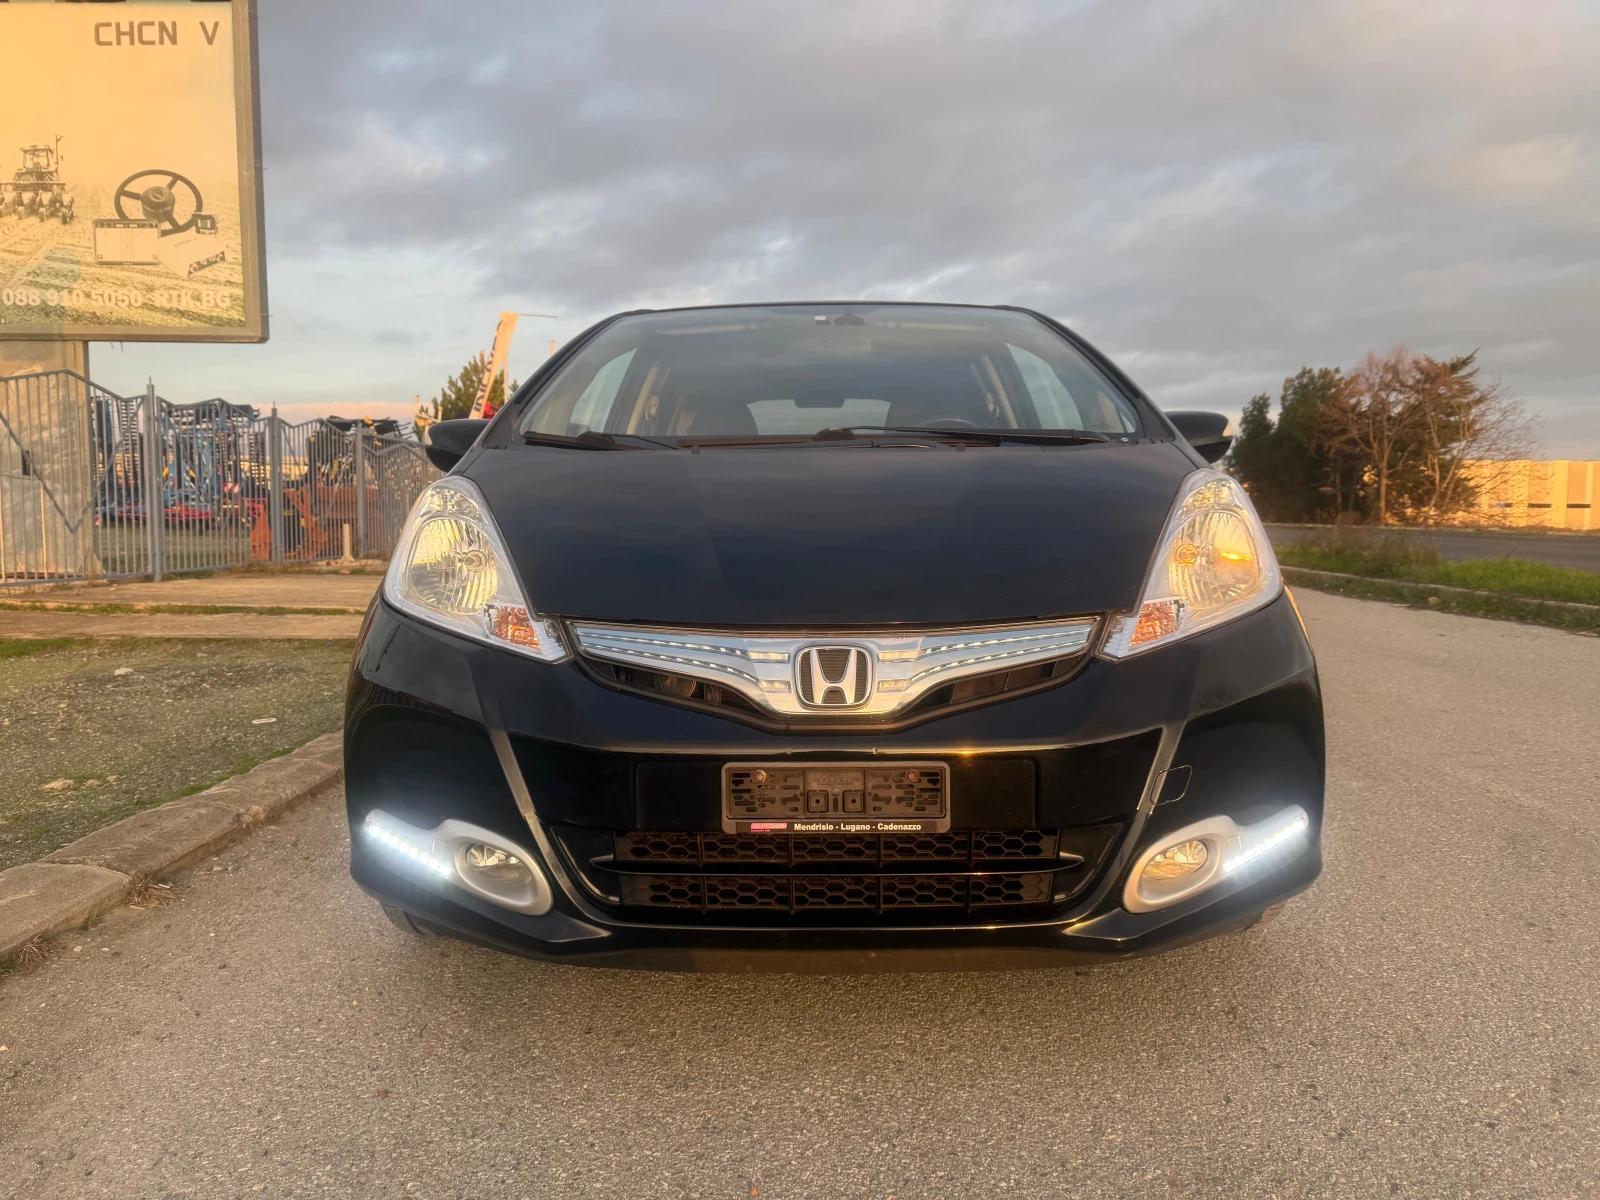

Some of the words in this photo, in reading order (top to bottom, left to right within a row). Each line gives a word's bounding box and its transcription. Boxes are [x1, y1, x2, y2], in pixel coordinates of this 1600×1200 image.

[2, 288, 41, 306] 088
[46, 288, 85, 307] 910
[90, 289, 142, 307] 5050
[153, 289, 231, 309] RTK.BG
[794, 823, 834, 831] Mendrisio
[840, 823, 871, 832] Lugano
[877, 823, 922, 831] Cadenazzo
